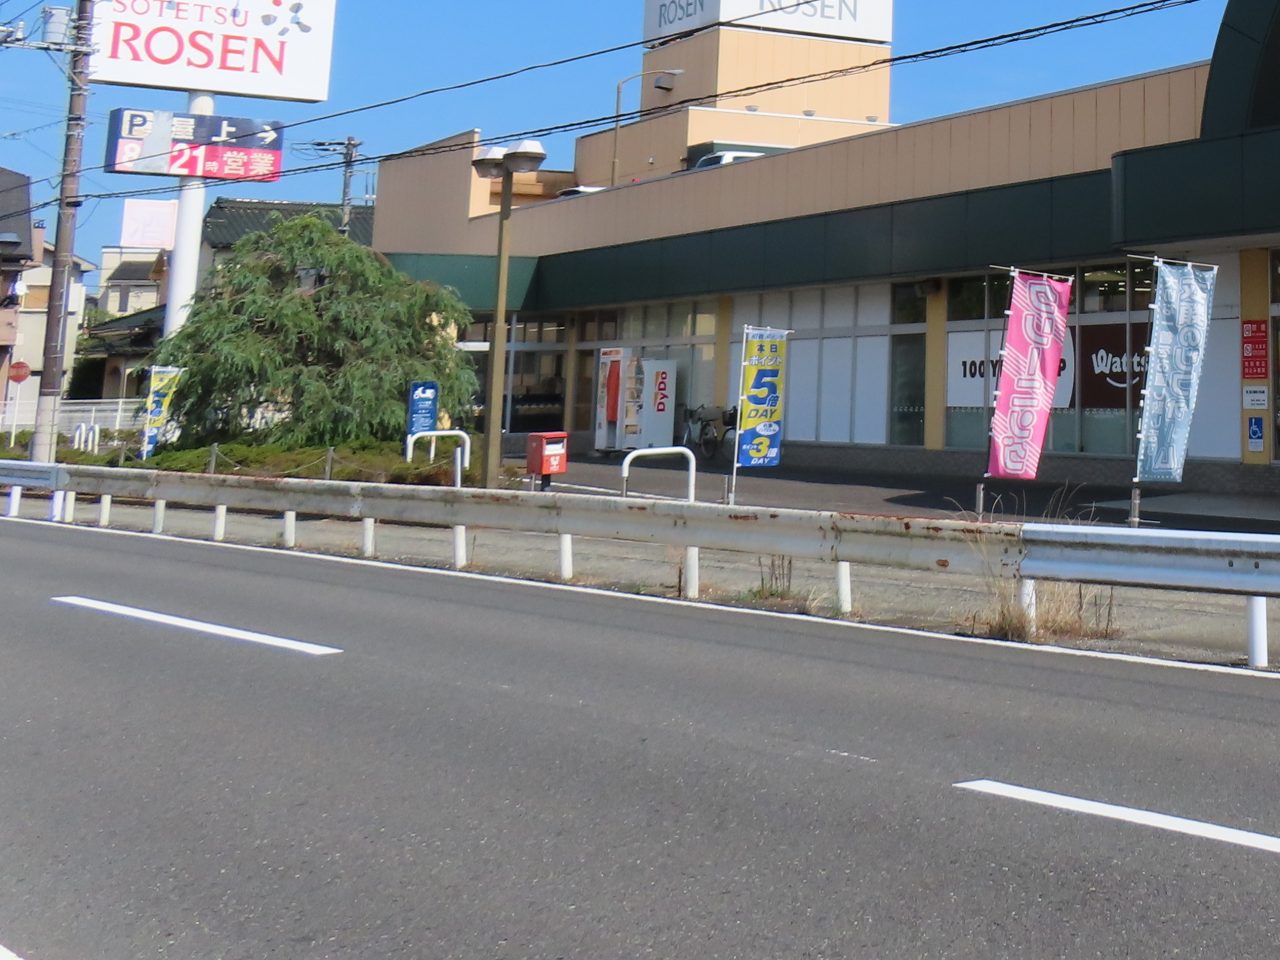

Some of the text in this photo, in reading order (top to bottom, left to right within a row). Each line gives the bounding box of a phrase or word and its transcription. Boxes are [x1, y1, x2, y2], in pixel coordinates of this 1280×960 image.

[107, 21, 288, 75] ROSEN
[128, 113, 148, 137] P
[757, 343, 778, 353] 本日
[750, 354, 783, 367] ポイント
[961, 360, 985, 378] 100
[747, 408, 778, 420] DAY
[751, 457, 770, 465] DAY
